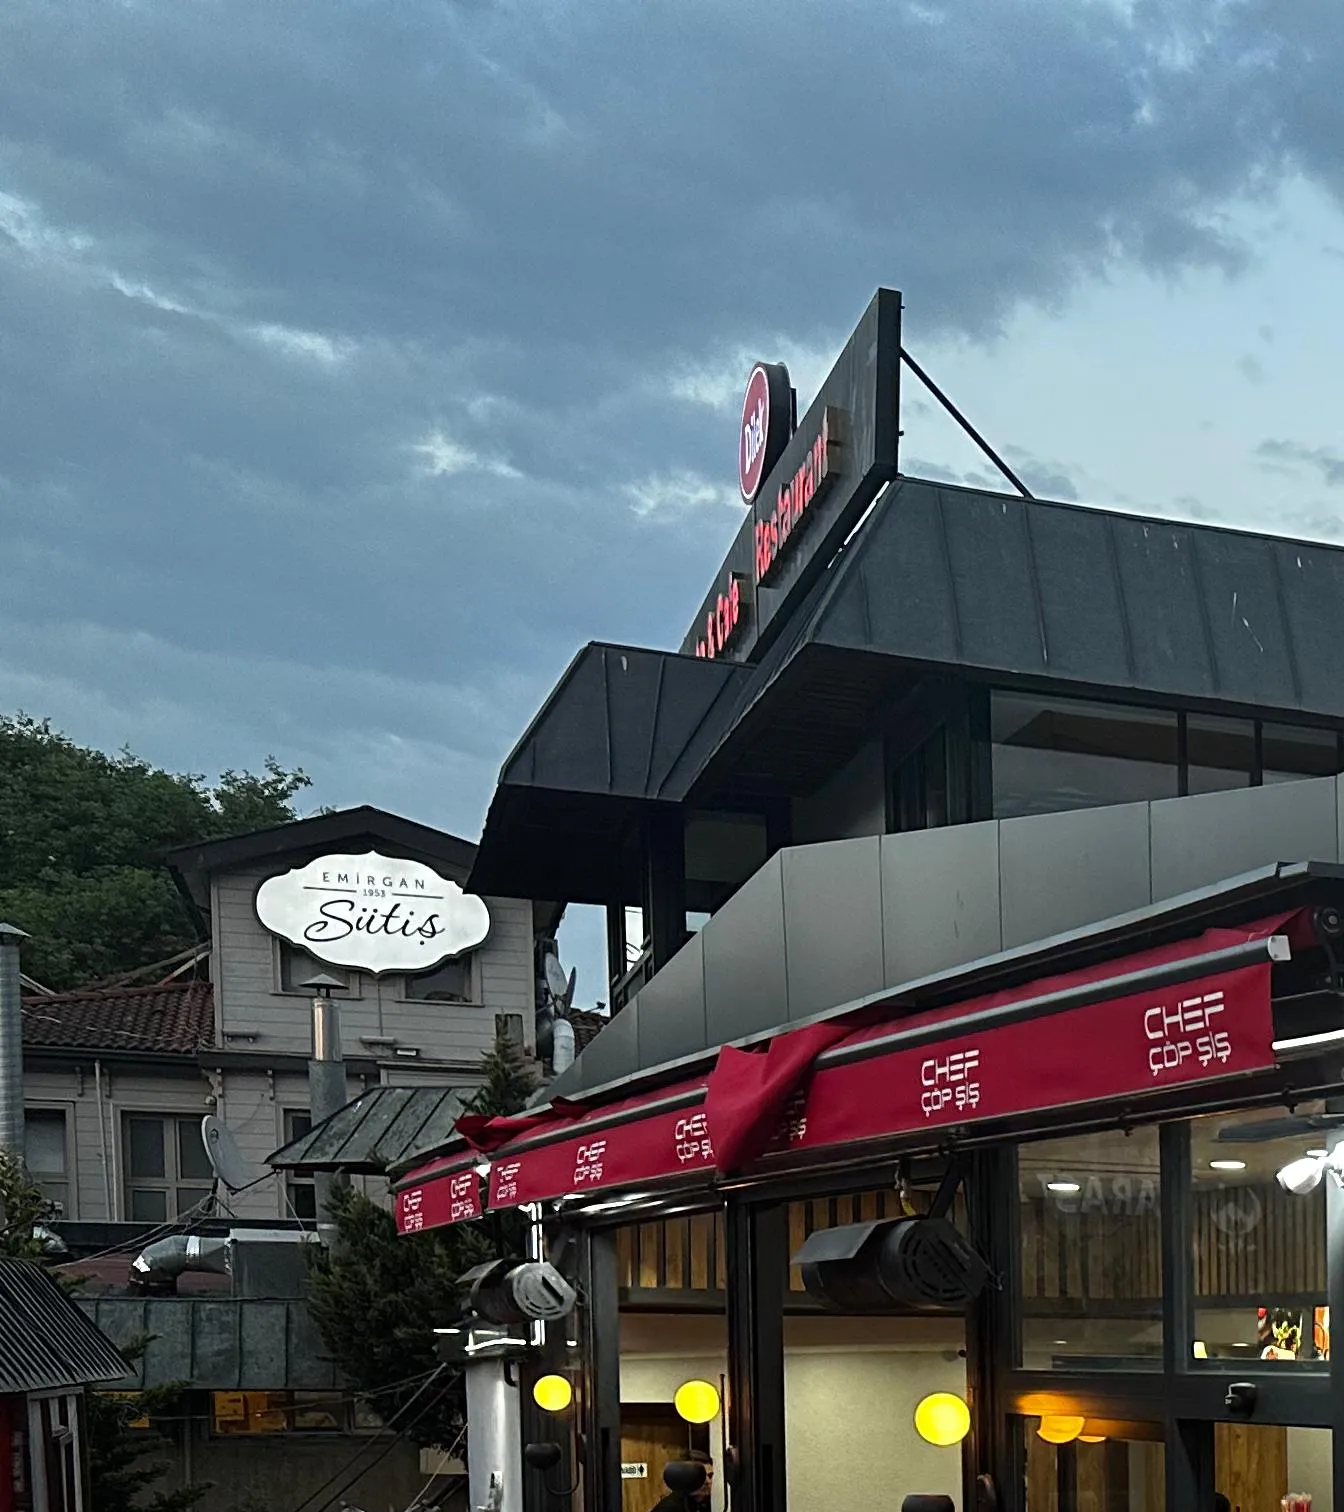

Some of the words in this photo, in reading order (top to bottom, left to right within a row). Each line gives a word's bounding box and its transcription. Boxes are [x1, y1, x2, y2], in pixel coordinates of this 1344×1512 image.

[755, 405, 828, 582] Restaurant
[322, 871, 426, 890] EMİRGAN
[363, 888, 387, 898] 1953
[303, 899, 447, 946] Sütiş
[1144, 991, 1225, 1040] CHEF
[921, 1049, 980, 1087] CHEF
[1149, 1040, 1193, 1077] ÇÖP
